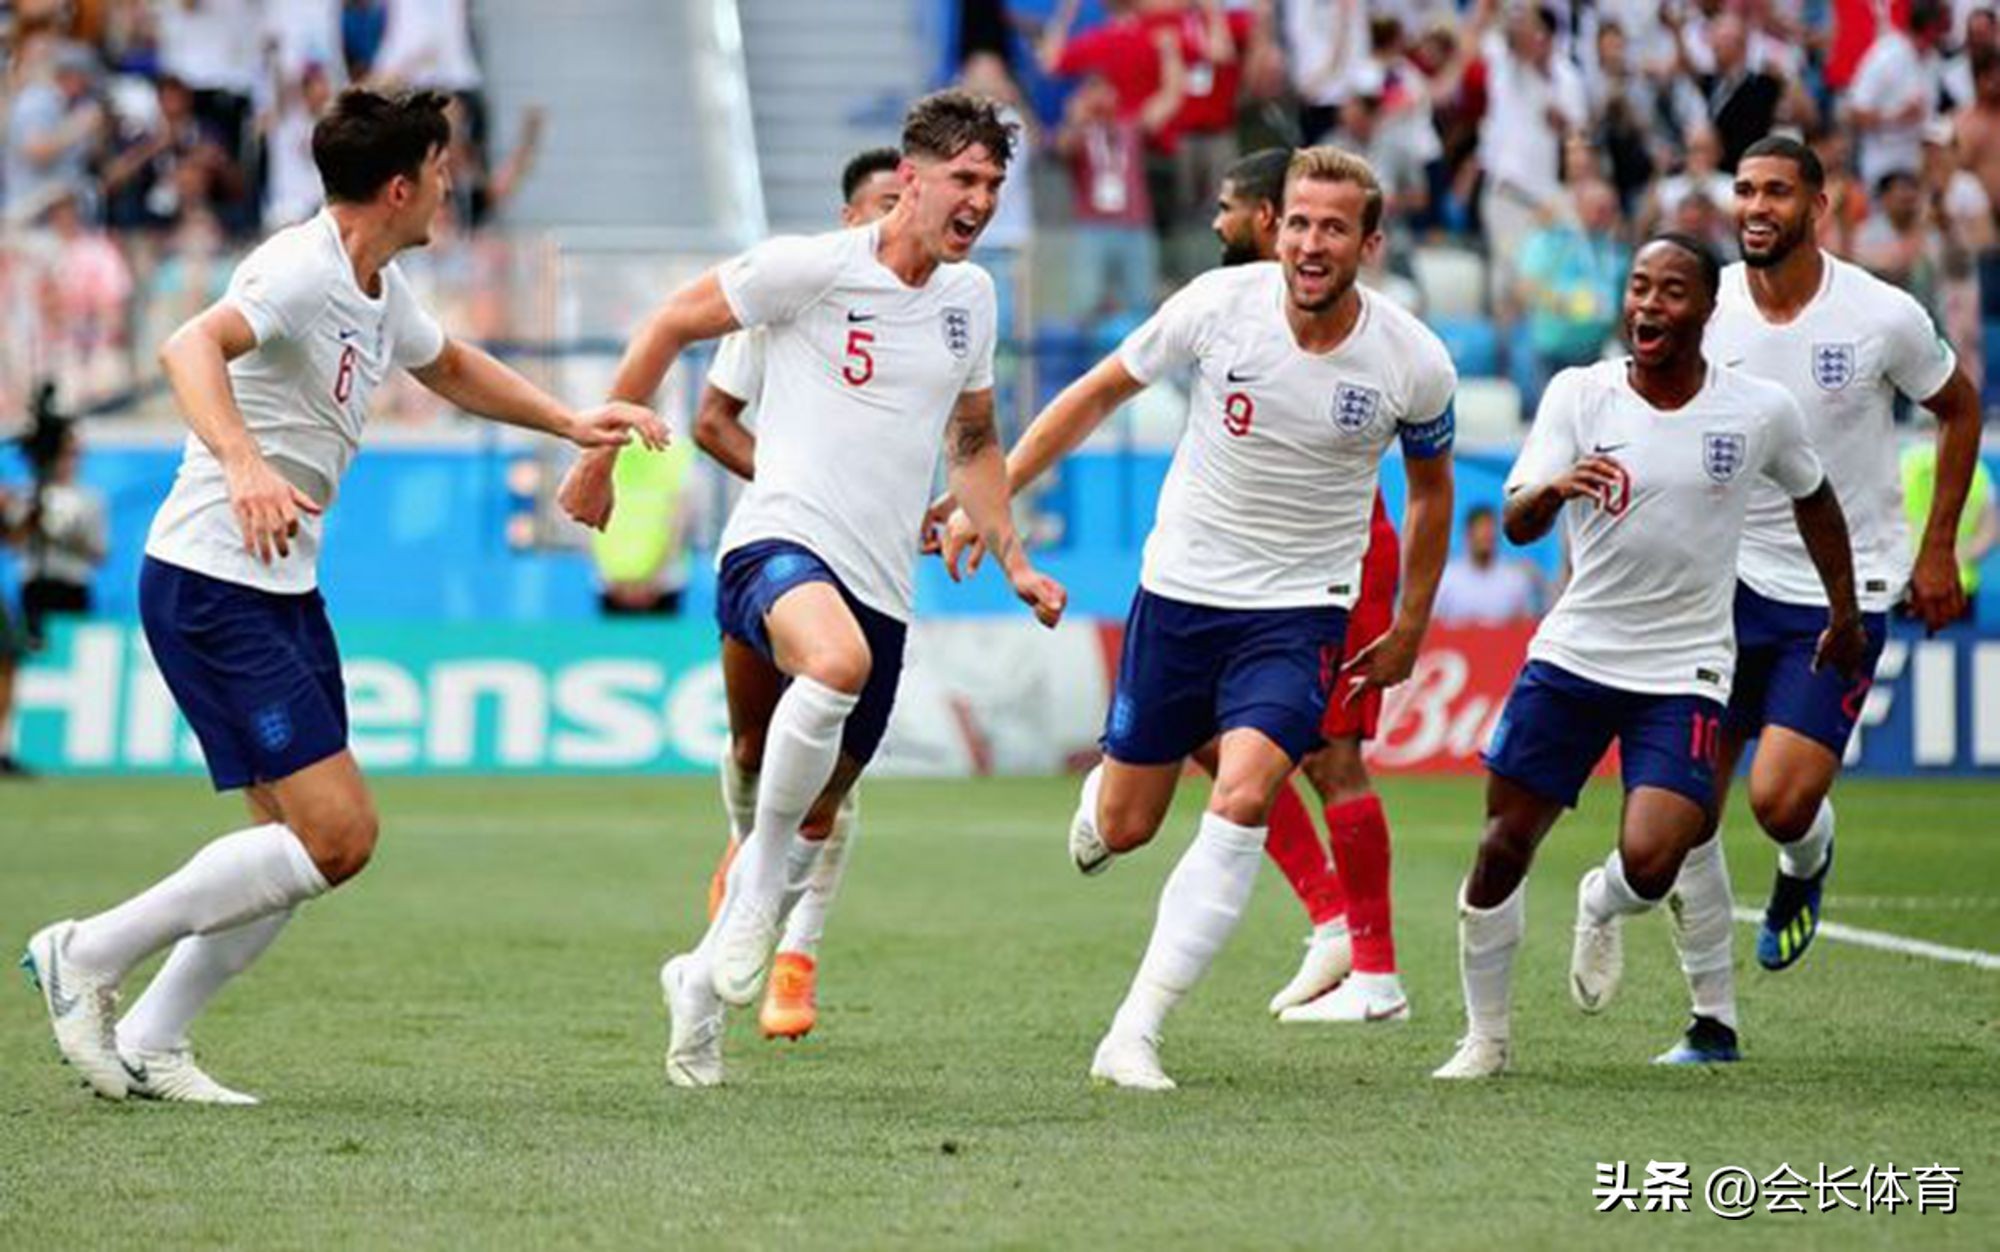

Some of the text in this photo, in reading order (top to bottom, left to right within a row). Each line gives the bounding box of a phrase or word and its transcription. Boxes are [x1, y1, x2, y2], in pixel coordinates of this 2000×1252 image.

[334, 344, 356, 404] 6
[843, 329, 875, 387] 5
[1223, 391, 1253, 437] 9
[13, 625, 734, 765] Hiense
